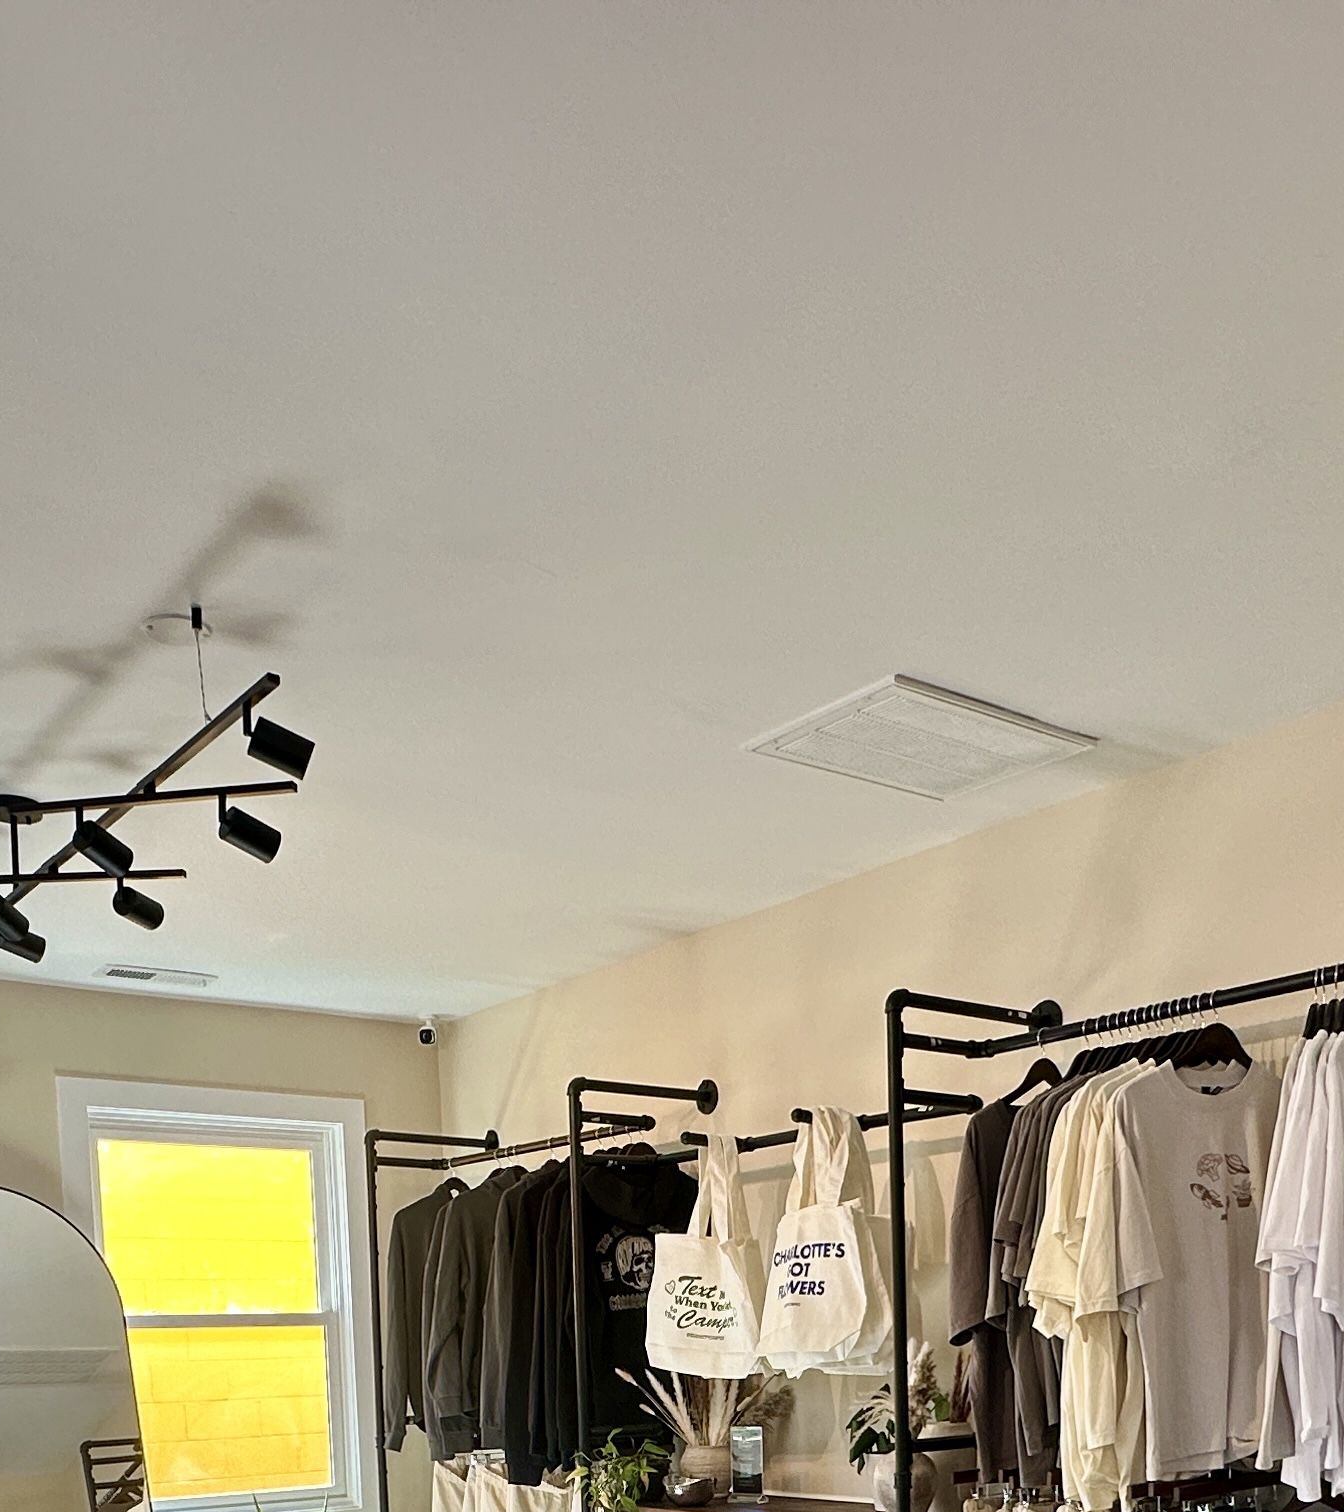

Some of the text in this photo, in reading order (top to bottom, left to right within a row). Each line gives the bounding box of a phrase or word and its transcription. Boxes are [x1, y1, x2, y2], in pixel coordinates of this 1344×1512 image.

[773, 1243, 846, 1267] CHLOTTE'S
[787, 1262, 811, 1278] OT
[678, 1275, 718, 1299] Text
[674, 1295, 707, 1310] When
